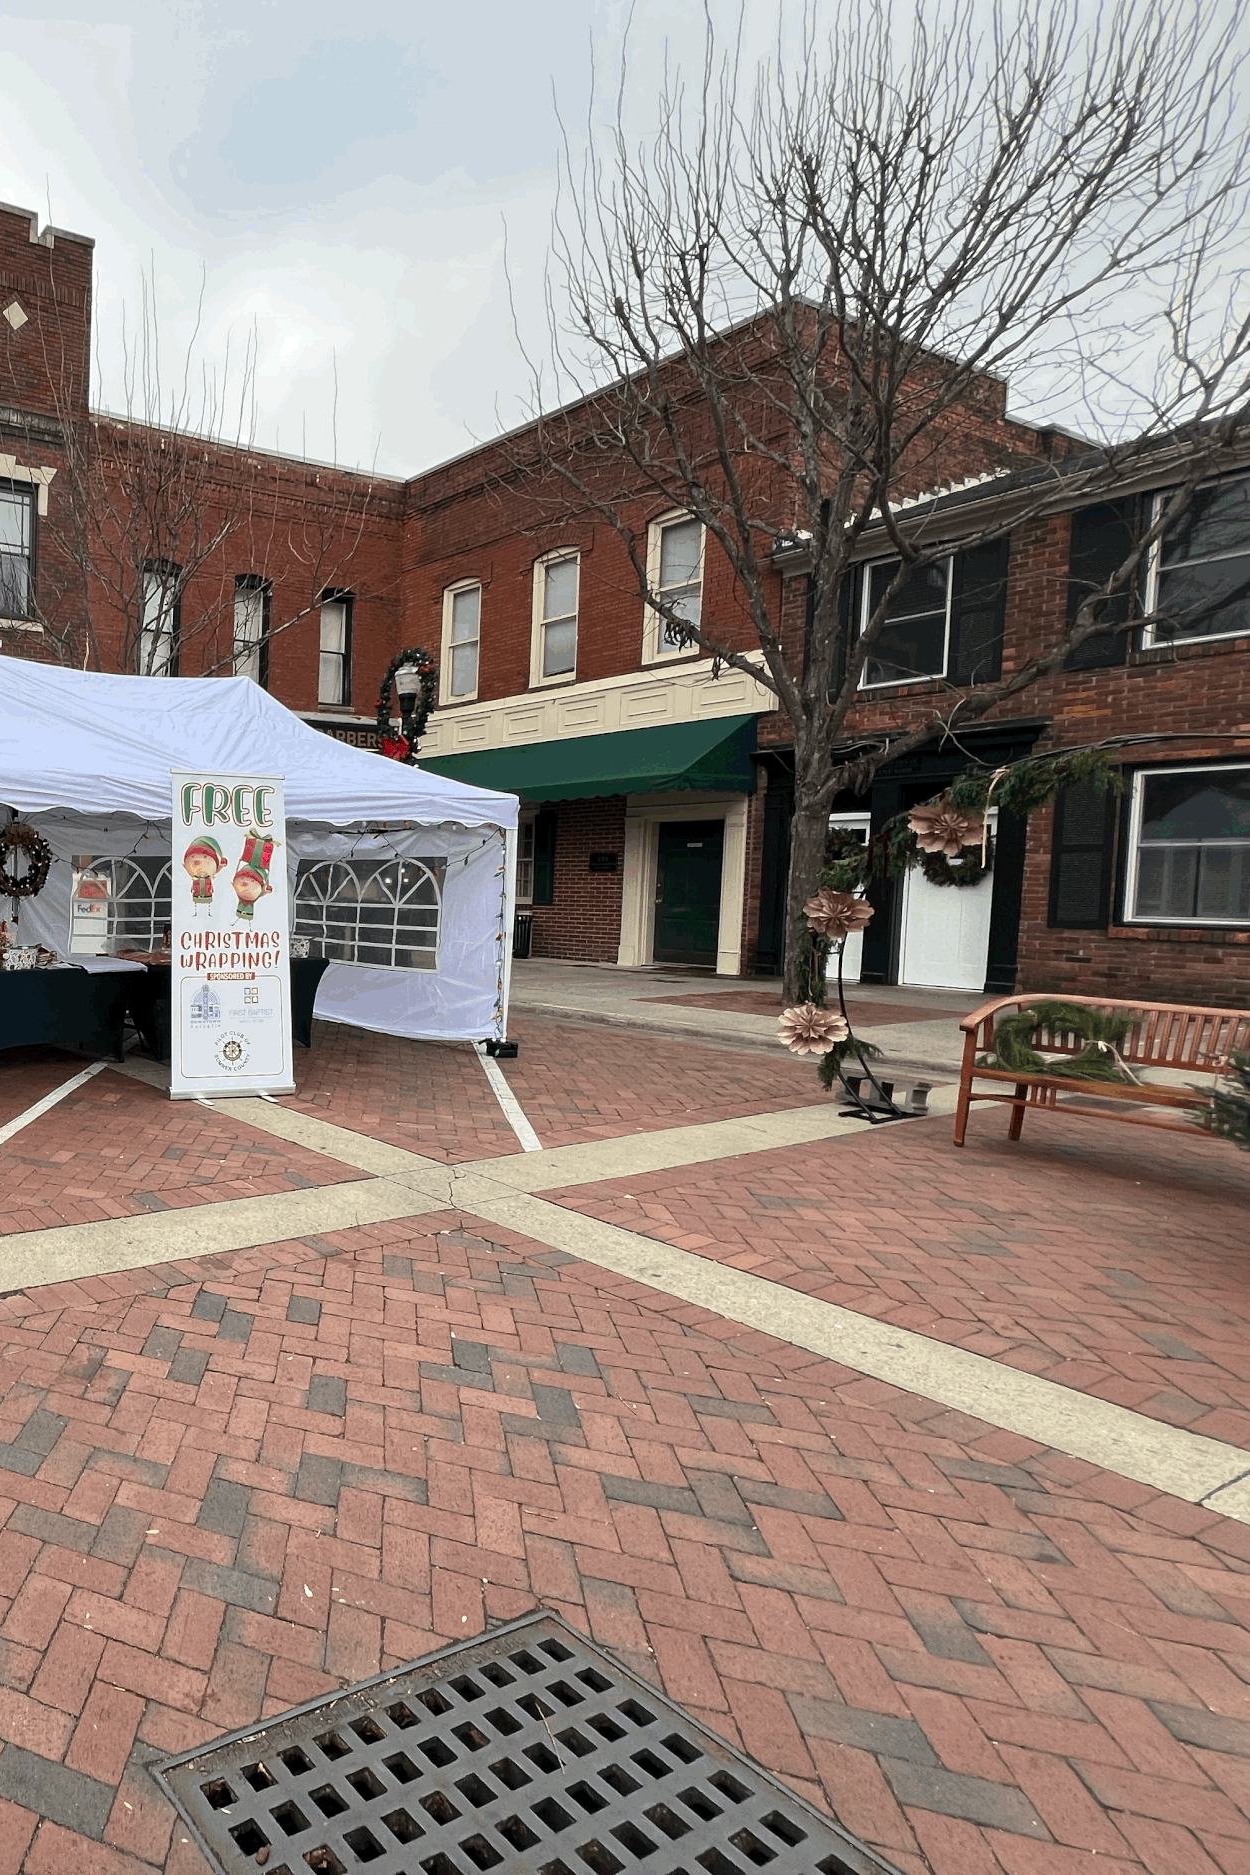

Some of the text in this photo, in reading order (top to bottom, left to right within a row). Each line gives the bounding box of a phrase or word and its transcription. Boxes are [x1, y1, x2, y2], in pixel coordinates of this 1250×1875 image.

[316, 728, 382, 748] RBER
[181, 782, 275, 828] FREE
[77, 902, 101, 913] FedEx
[180, 931, 280, 951] CHRISTMAS
[180, 951, 280, 971] WRAPPING!
[209, 972, 253, 981] SPONSORED BY
[247, 1008, 274, 1016] BAPTIST
[214, 1031, 229, 1046] PILOT
[229, 1031, 245, 1039] CLUB
[214, 1053, 251, 1072] SUMNER COUNTY
